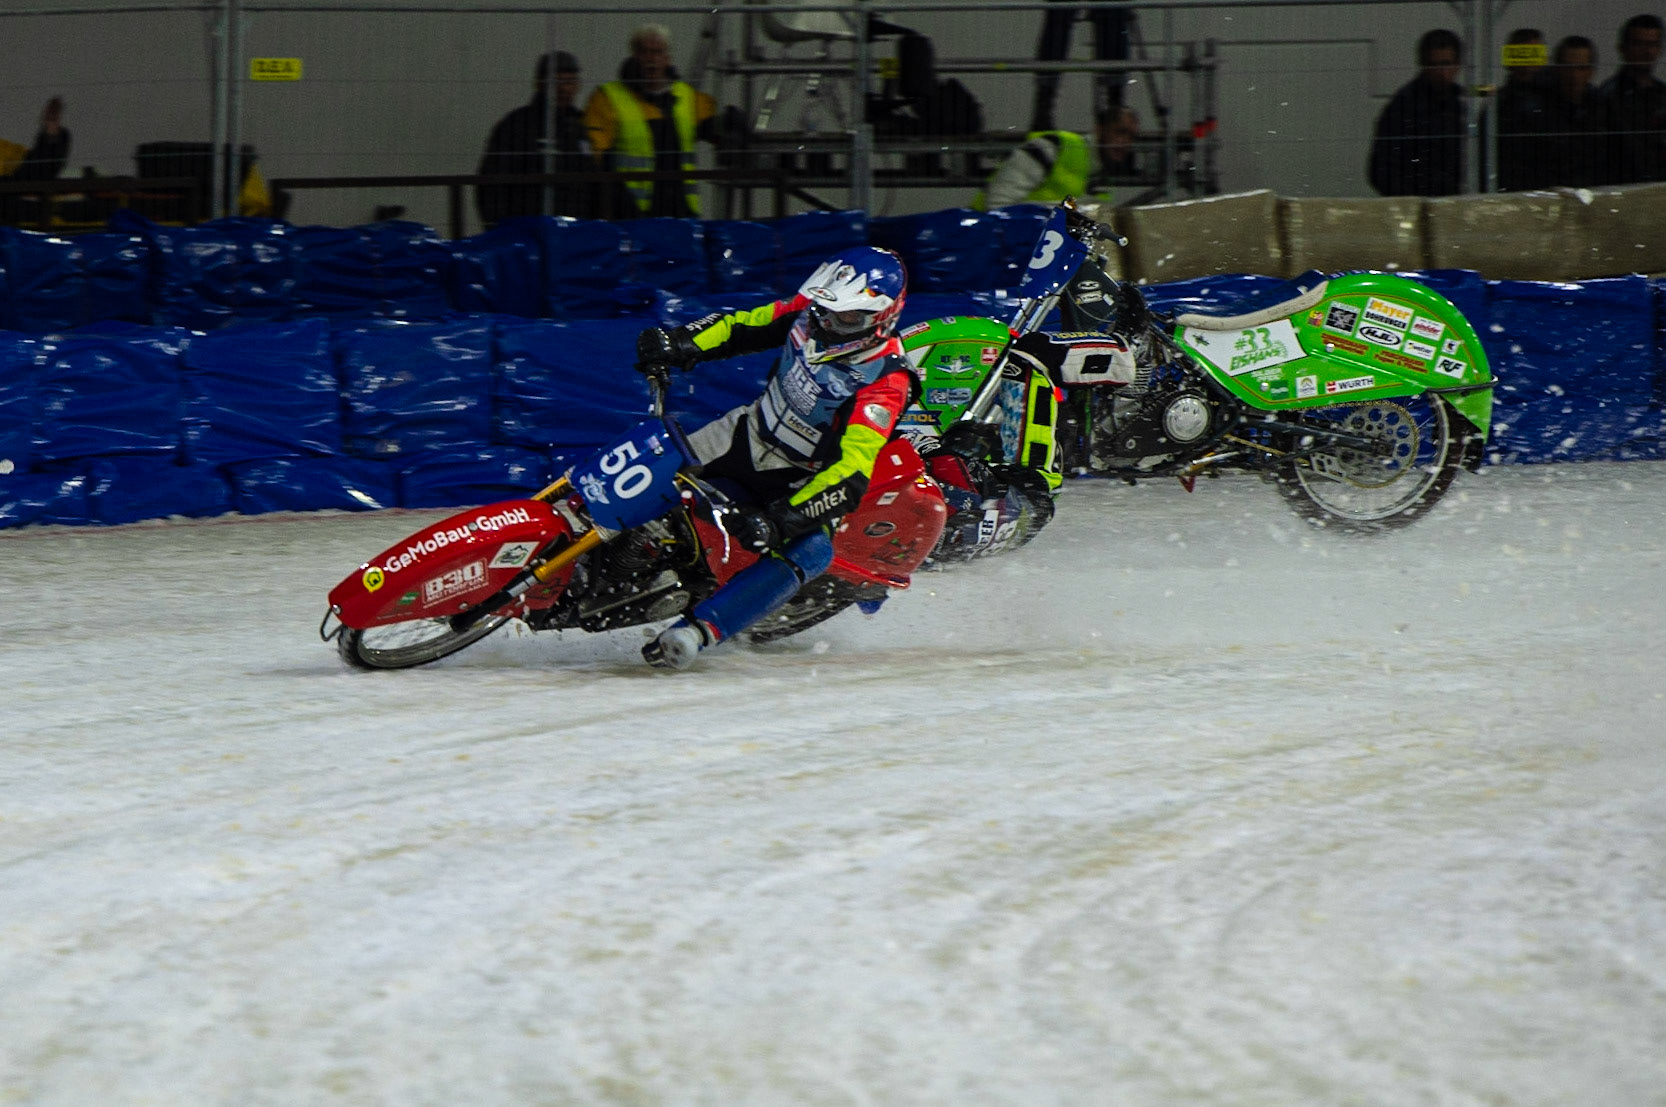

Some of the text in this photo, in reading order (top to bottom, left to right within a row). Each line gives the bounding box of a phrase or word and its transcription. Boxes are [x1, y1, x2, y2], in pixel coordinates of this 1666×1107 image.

[1028, 230, 1065, 269] 3
[1371, 300, 1410, 319] Mayer
[789, 416, 818, 438] Hertz
[599, 440, 653, 499] 50
[385, 507, 531, 573] GeMoBau GmbH
